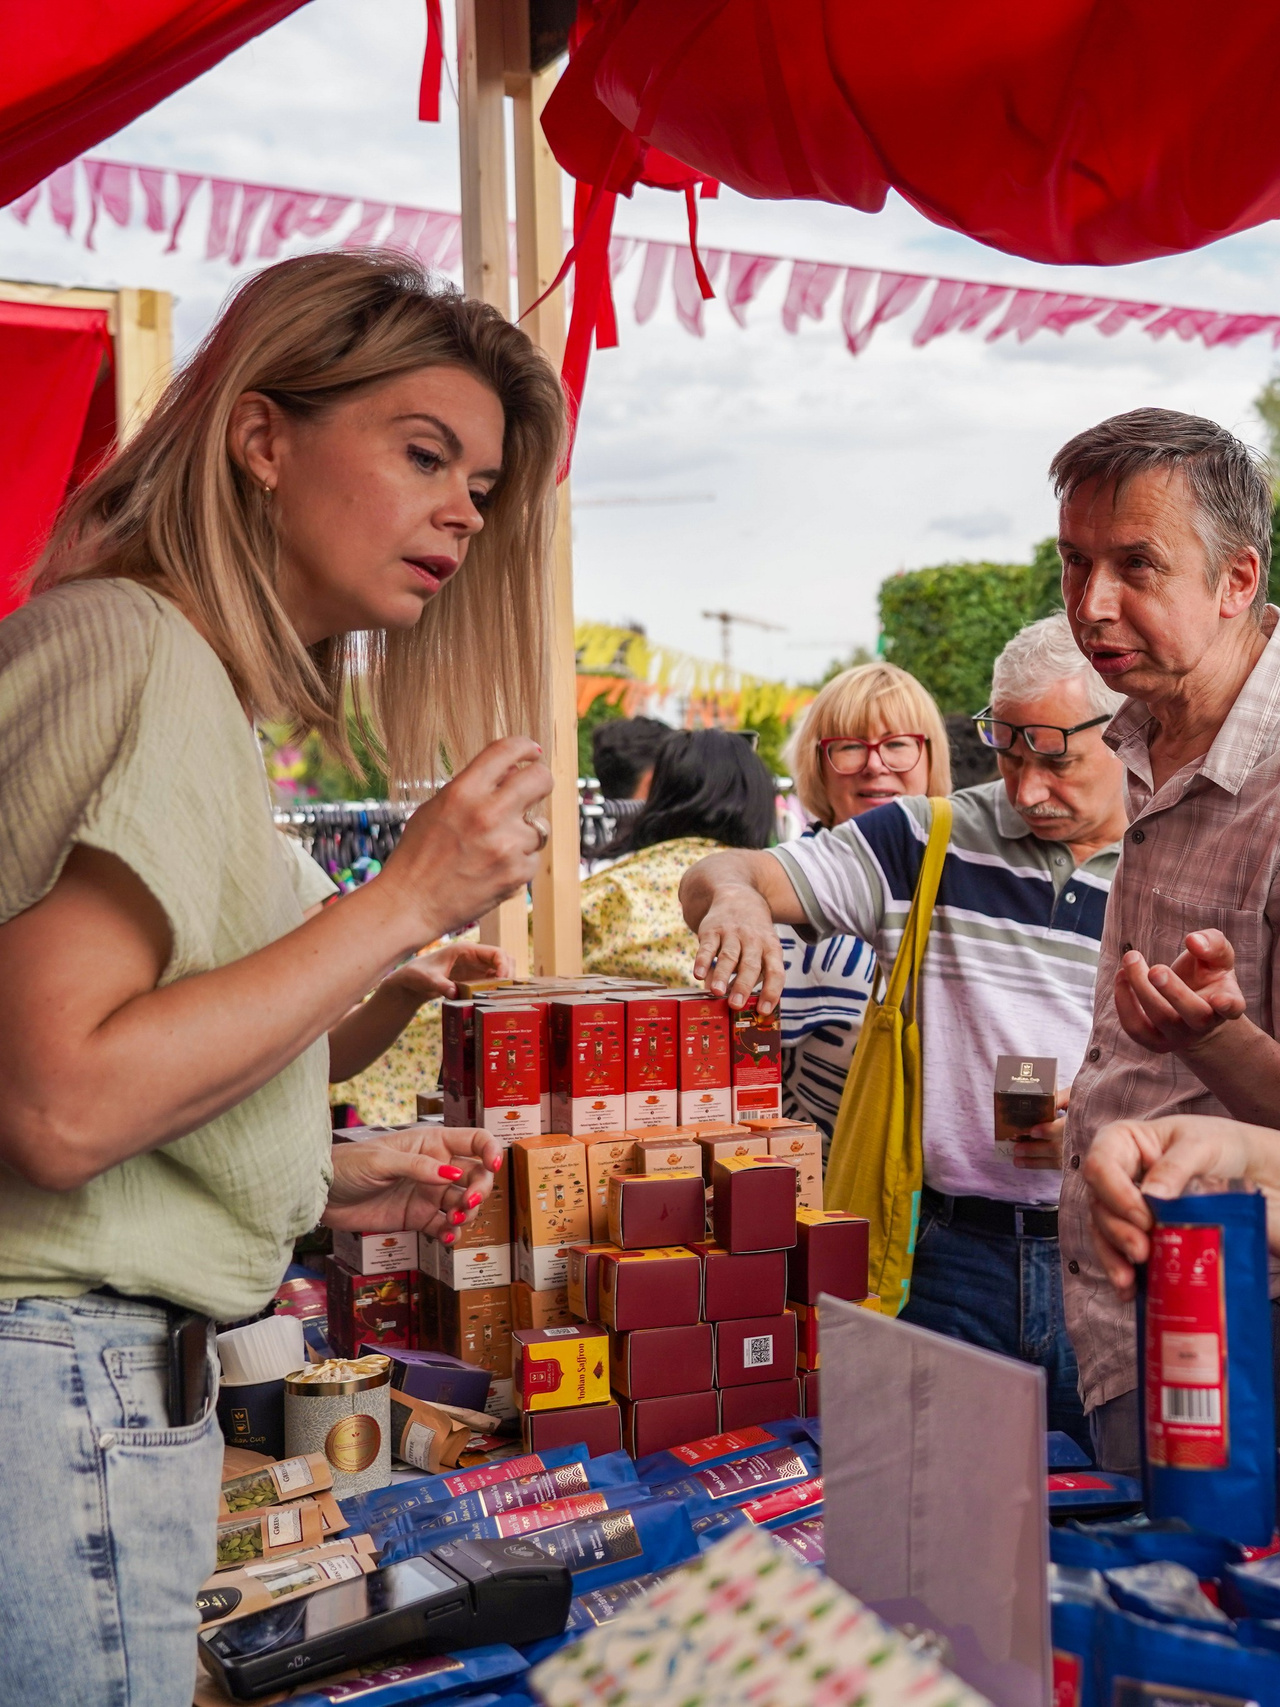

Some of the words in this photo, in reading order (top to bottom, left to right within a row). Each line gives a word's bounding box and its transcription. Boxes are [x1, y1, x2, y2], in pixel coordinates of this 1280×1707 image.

[577, 1343, 587, 1373] Saffron
[577, 1376, 585, 1401] Indian
[250, 1435, 267, 1444] Cup
[507, 1513, 518, 1523] Tea
[273, 1518, 281, 1535] GREEN
[510, 1521, 521, 1534] each
